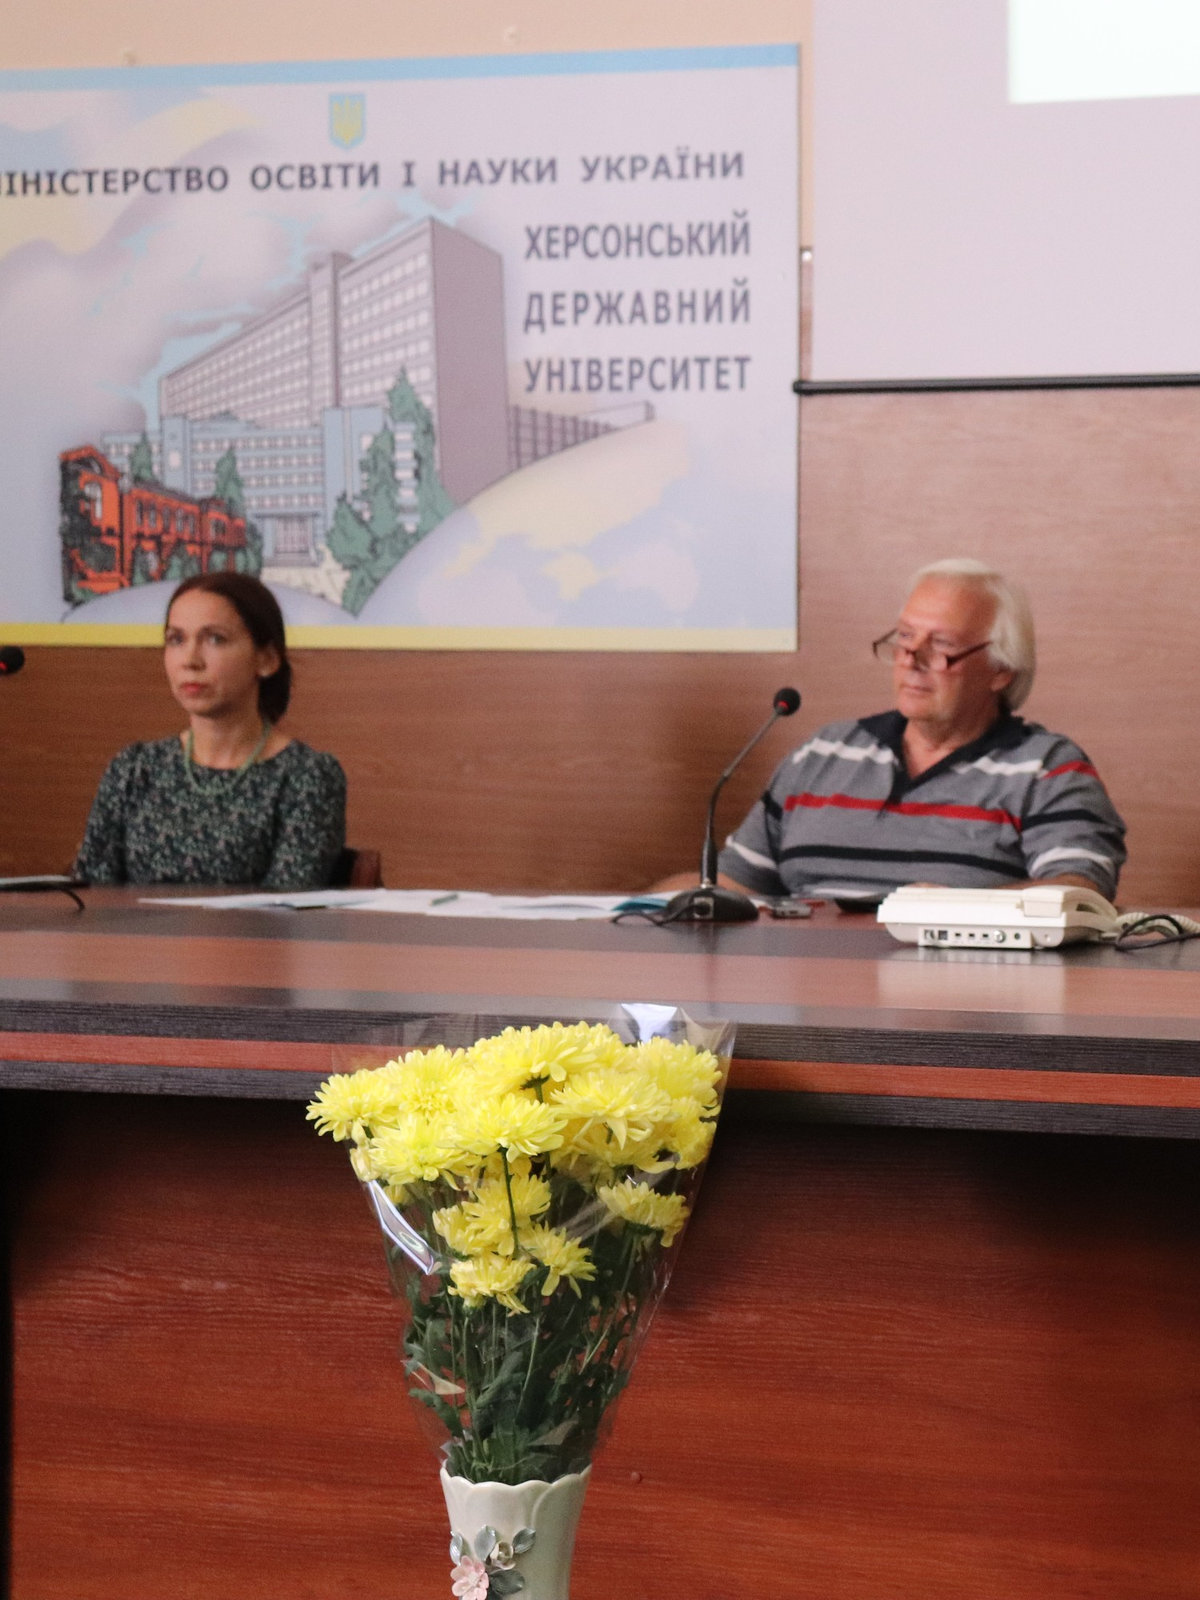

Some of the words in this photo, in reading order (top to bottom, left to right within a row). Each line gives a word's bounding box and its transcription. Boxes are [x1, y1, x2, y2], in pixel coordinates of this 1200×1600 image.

[0, 166, 229, 197] ІНІСТЕРСТВО
[250, 162, 380, 192] ОСВІТИ
[402, 160, 416, 187] І
[438, 157, 558, 186] НАУКИ
[581, 146, 745, 183] УКРАЇНИ
[524, 209, 750, 260] ХЕРСОНСЬКИЙ
[523, 277, 750, 335] ДЕРЖАВНИЙ
[524, 356, 752, 393] УНІВЕРСИТЕТ
